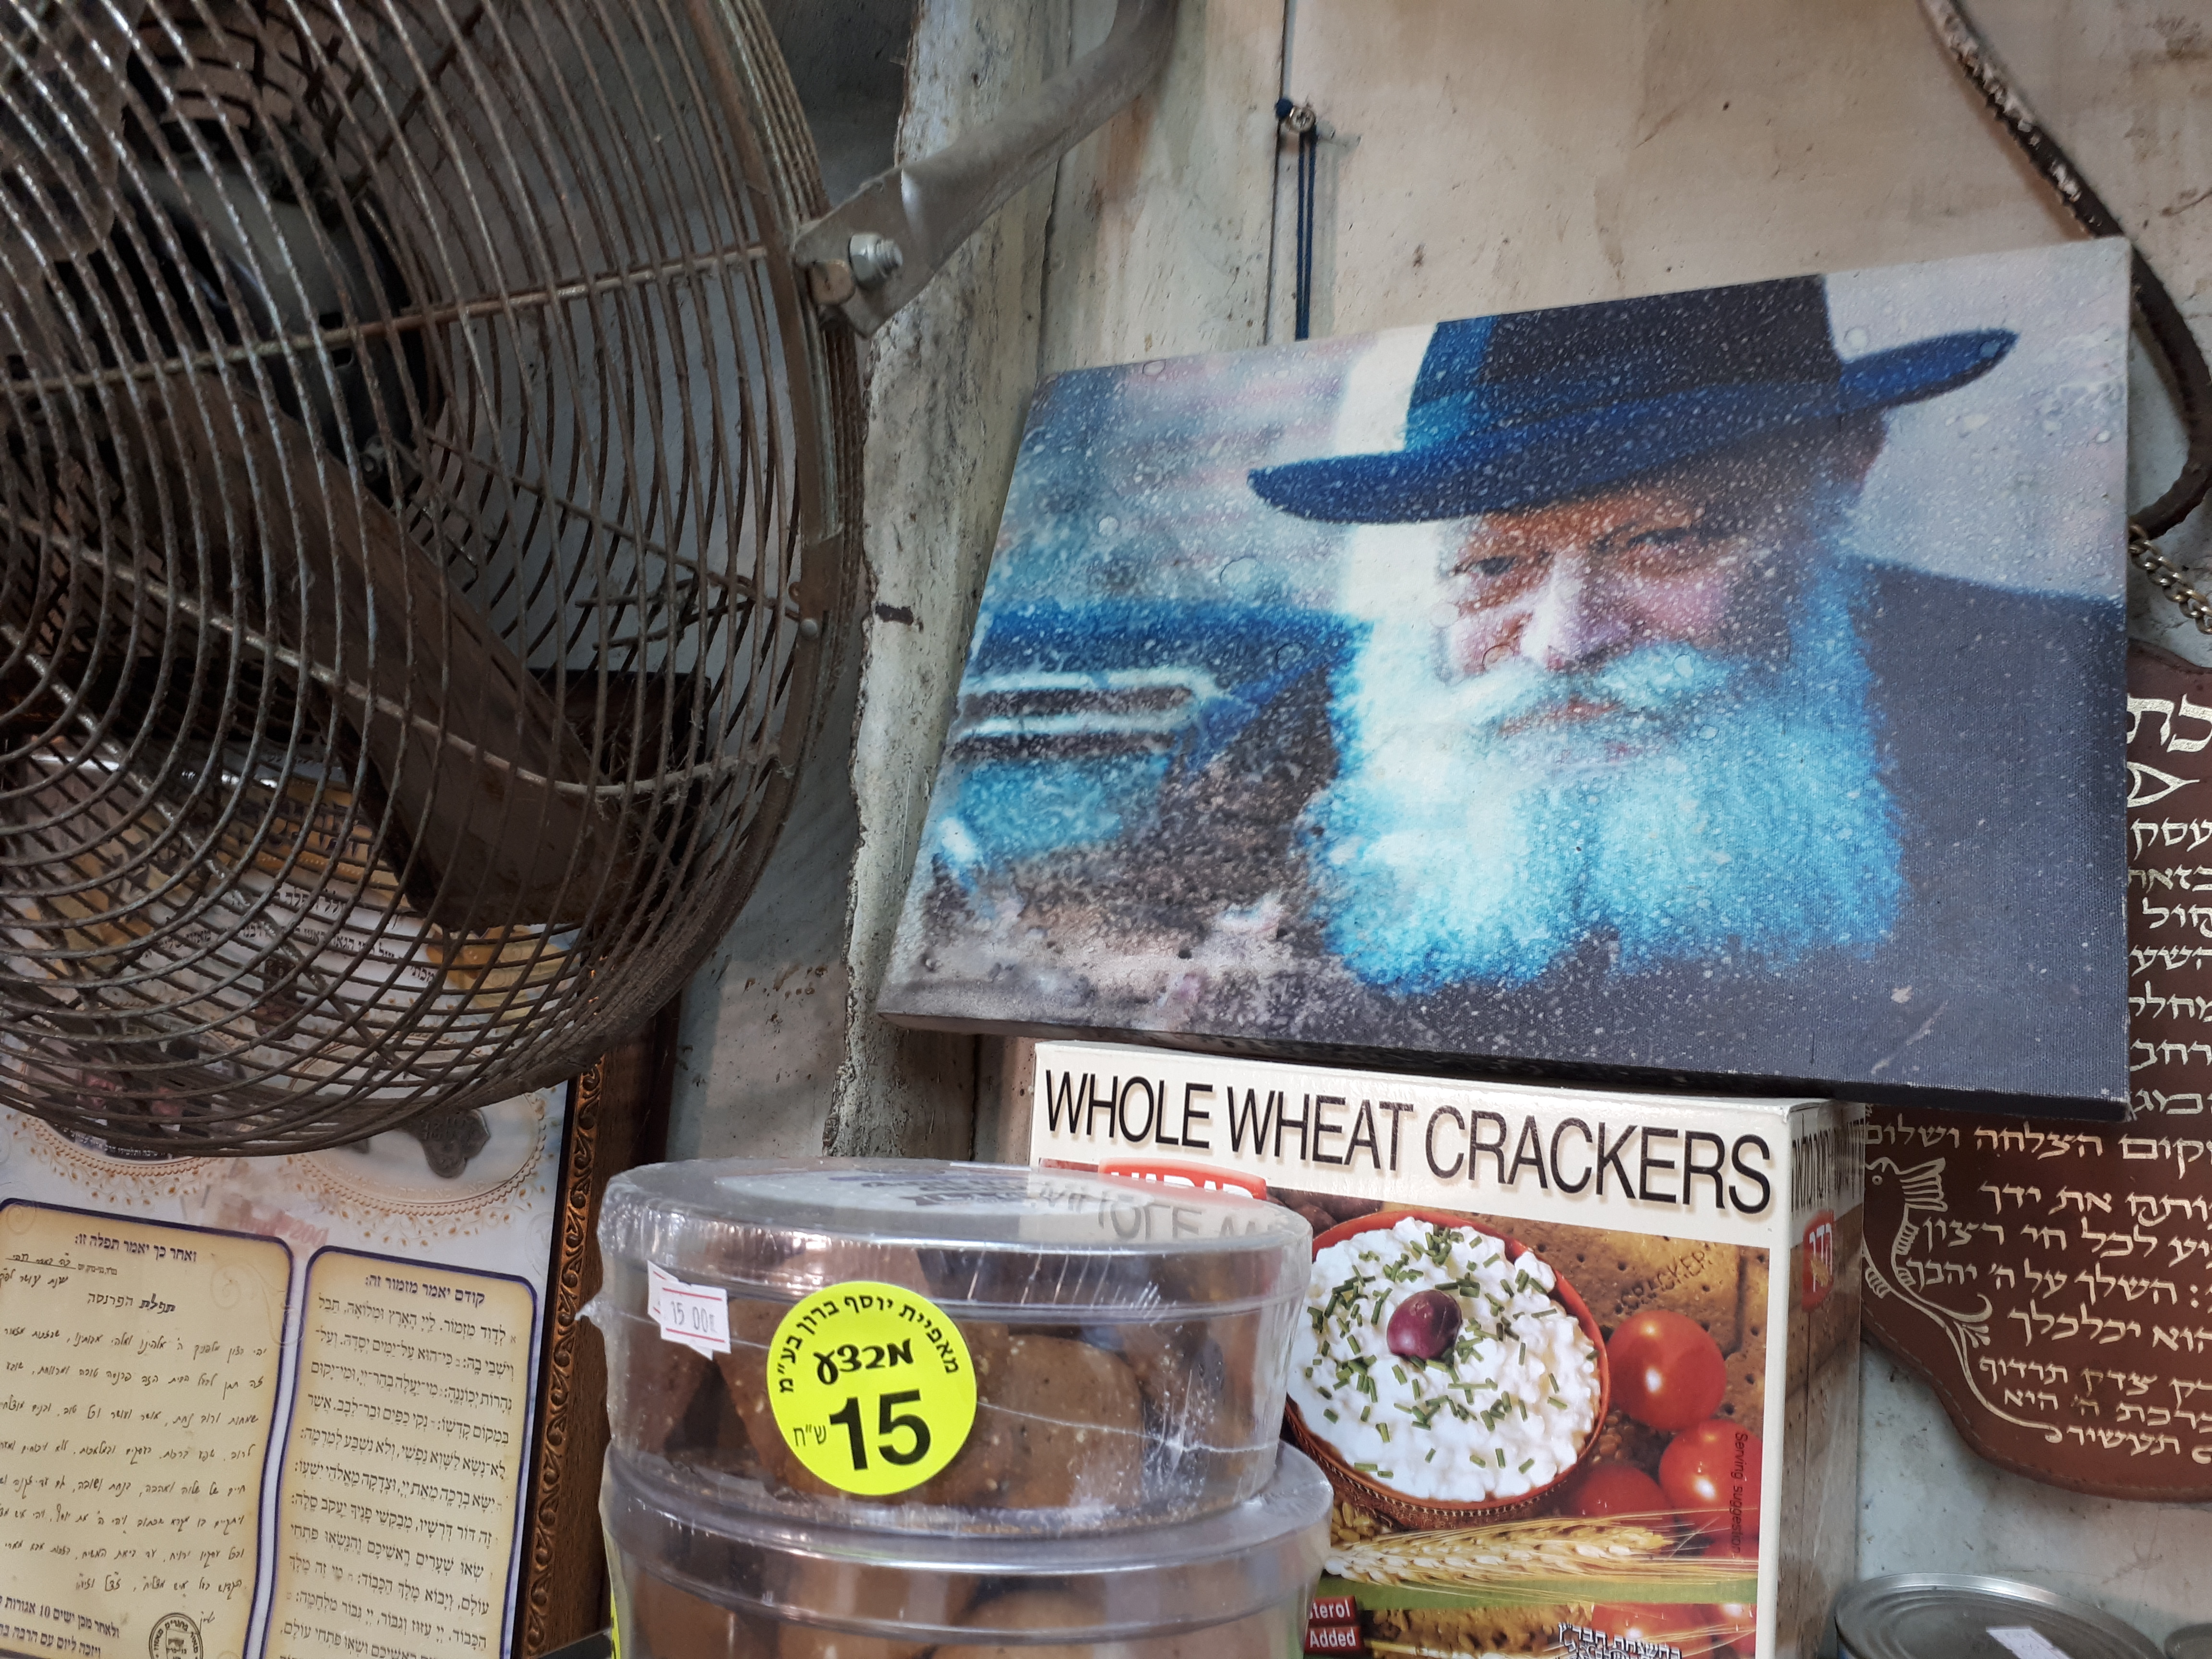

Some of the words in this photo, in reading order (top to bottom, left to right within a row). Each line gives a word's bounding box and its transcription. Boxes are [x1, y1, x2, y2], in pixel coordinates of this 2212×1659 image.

[1865, 1113, 1960, 1148] ושלום
[1974, 1121, 2103, 1160] הצלחה
[1046, 1070, 1213, 1149] WHOLE
[1227, 1086, 1413, 1170] WHEAT
[1425, 1105, 1771, 1214] CRACKERS
[1977, 1181, 2041, 1214] ידך
[2048, 1186, 2112, 1215] את
[75, 1233, 86, 1245] זו:
[90, 1232, 120, 1250] תפלה
[1923, 1216, 2004, 1252] רצון
[2020, 1225, 2067, 1251] חי
[2081, 1216, 2157, 1258] לכל
[124, 1240, 149, 1254] יאמר
[154, 1245, 166, 1260] כך
[170, 1248, 196, 1262] ואחר
[365, 1274, 381, 1286] זה:
[1906, 1257, 1977, 1292] יהבך
[2024, 1258, 2067, 1299] על
[2074, 1261, 2177, 1306] השלך
[385, 1277, 418, 1294] מזמור
[422, 1284, 450, 1298] יאמר
[87, 1293, 133, 1308] הפרנסה
[139, 1293, 176, 1314] תפלת
[455, 1289, 484, 1308] קודם
[844, 1295, 893, 1313] יוסף
[796, 1300, 840, 1335] ברון
[2008, 1298, 2141, 1346] יכלכלך
[899, 1304, 959, 1373] מאפיית
[814, 1338, 914, 1385] מבצע
[1979, 1356, 2068, 1384] תרדוף
[2081, 1368, 2157, 1396] צדק
[2005, 1388, 2058, 1410] היא
[829, 1389, 931, 1471] 15
[2067, 1425, 2180, 1456] תעשיר
[1731, 1433, 1748, 1479] Serving
[1729, 1486, 1743, 1553] suggestion
[4, 1597, 36, 1614] אגורות
[40, 1605, 50, 1618] 10
[53, 1608, 74, 1624] ישים
[78, 1615, 92, 1630] מכן
[95, 1620, 119, 1638] ולאחר
[12, 1626, 38, 1643] הרבה
[40, 1633, 54, 1647] עם
[57, 1635, 76, 1652] ליום
[1310, 1626, 1356, 1647] Added
[79, 1642, 100, 1656] ויזכה
